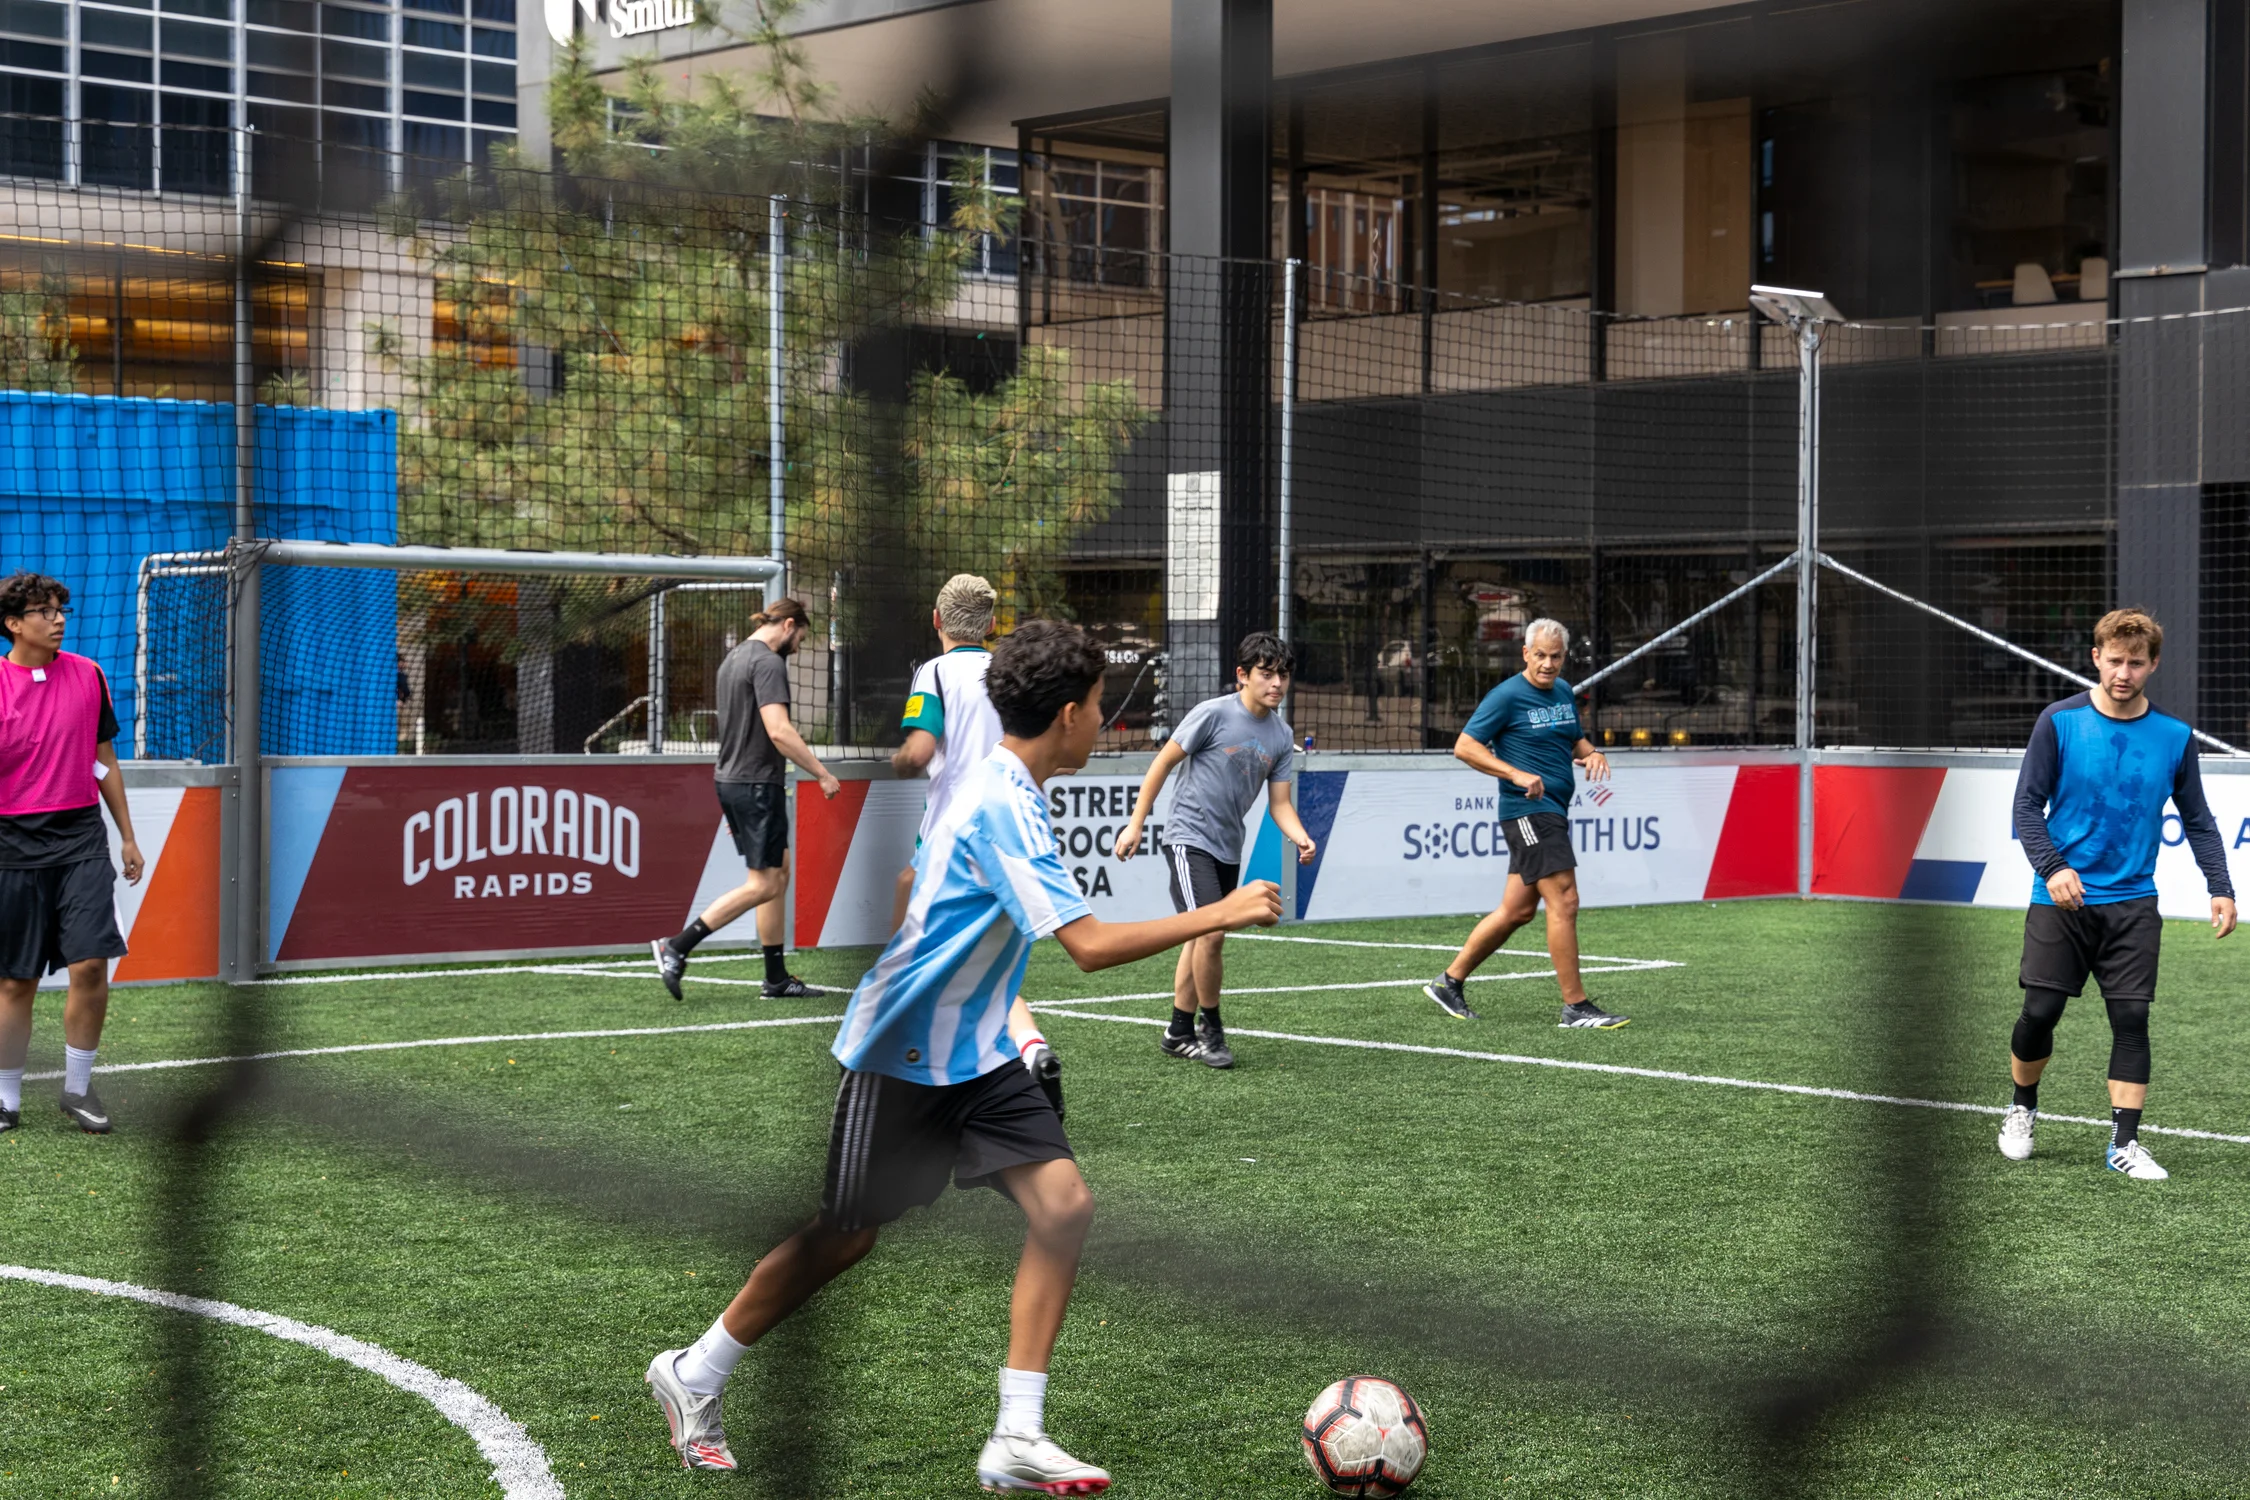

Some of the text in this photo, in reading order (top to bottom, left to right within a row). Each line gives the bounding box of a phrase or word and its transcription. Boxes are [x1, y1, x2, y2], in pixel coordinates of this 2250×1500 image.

[1050, 785, 1154, 818] STREE
[1455, 796, 1494, 810] BANK
[403, 785, 640, 886] COLORADO
[1623, 816, 1660, 850] US
[454, 871, 593, 899] RAPIDS
[1073, 865, 1113, 897] SA
